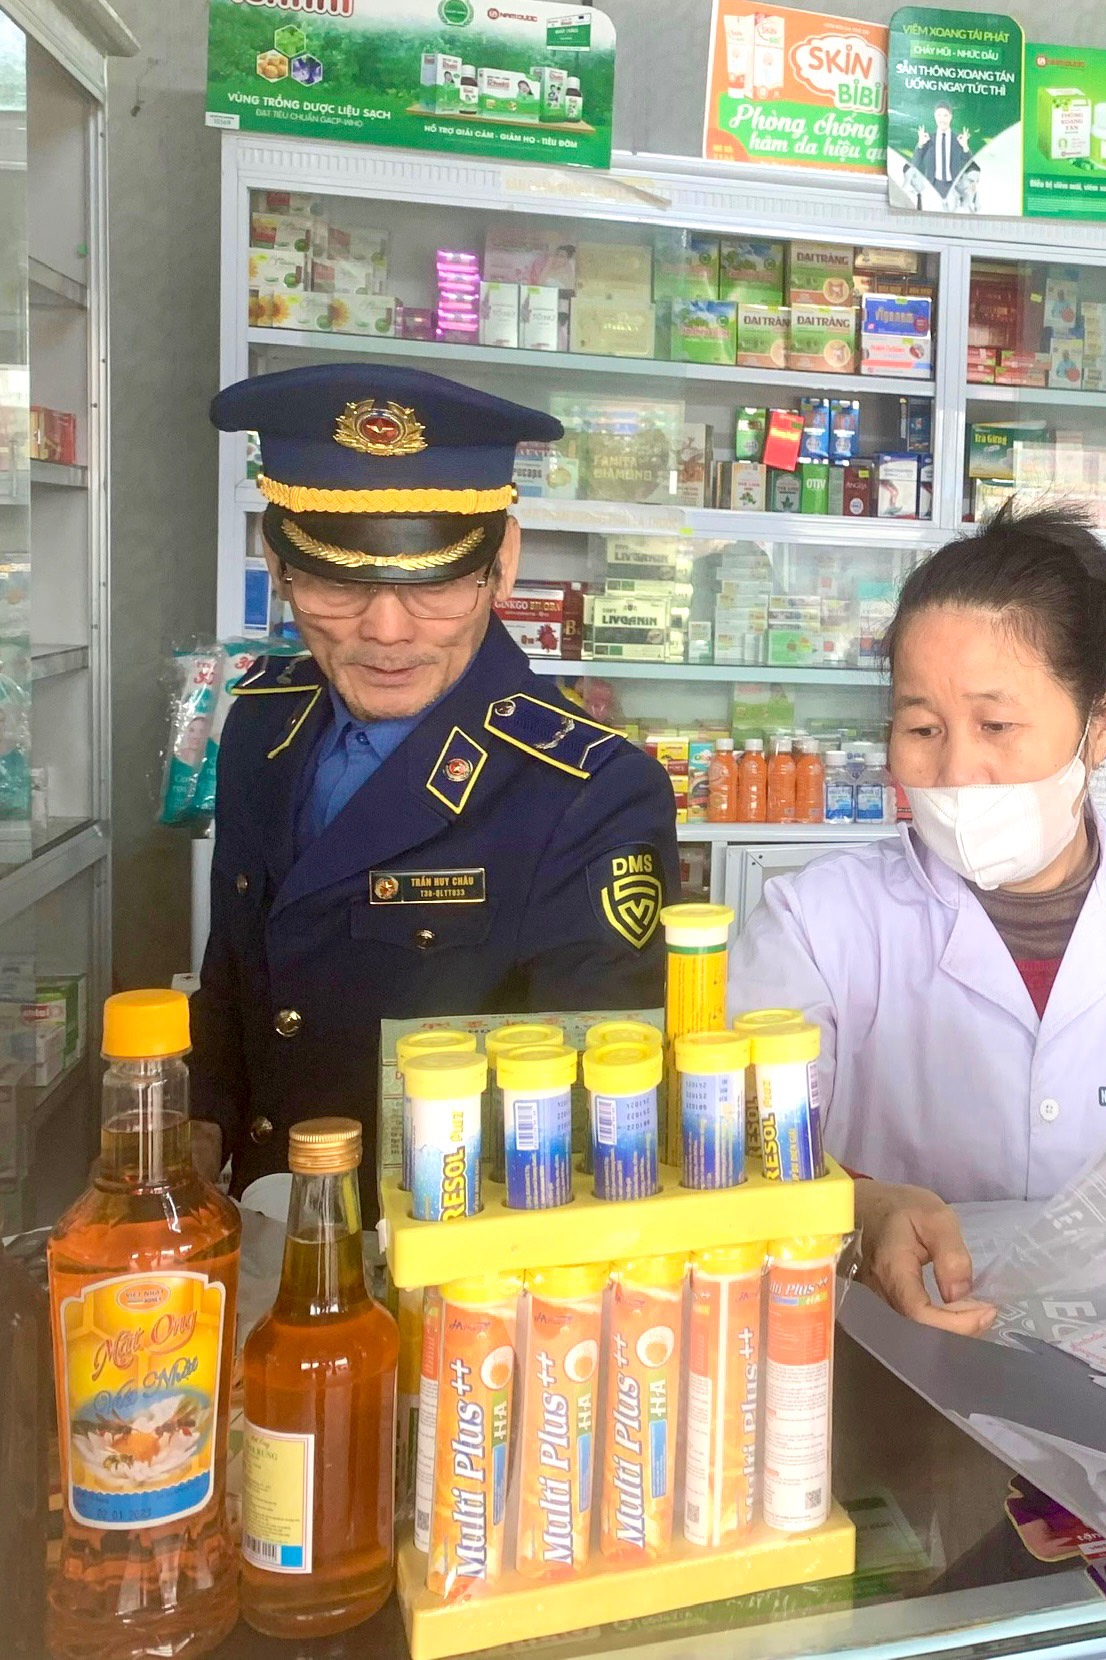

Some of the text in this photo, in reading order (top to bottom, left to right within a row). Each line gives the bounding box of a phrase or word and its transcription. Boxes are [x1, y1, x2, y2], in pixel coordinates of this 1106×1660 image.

[903, 24, 1009, 43] VIÊM XOANG TÁI PHÁT
[905, 77, 1007, 96] UỐNG NGAY TỨC THÌ
[919, 64, 1015, 83] THÔNG XOANG TÁN
[227, 91, 391, 121] VÙNG TRỒNG DƯỢC LIỆU SẠCH
[729, 104, 880, 147] Phòng chống
[795, 134, 818, 157] da
[823, 137, 860, 161] hiệu
[816, 252, 849, 266] TRÀNG
[817, 314, 850, 330] TRÀNG
[806, 478, 826, 490] OTIV
[612, 854, 653, 877] DMS
[411, 875, 475, 887] TRẦN HUY CHÂU
[576, 1391, 594, 1433] HA
[648, 1378, 667, 1420] HA
[492, 1399, 509, 1442] HA
[611, 1454, 647, 1548] Multi
[450, 1487, 487, 1580] Multi
[538, 1477, 573, 1566] Multi
